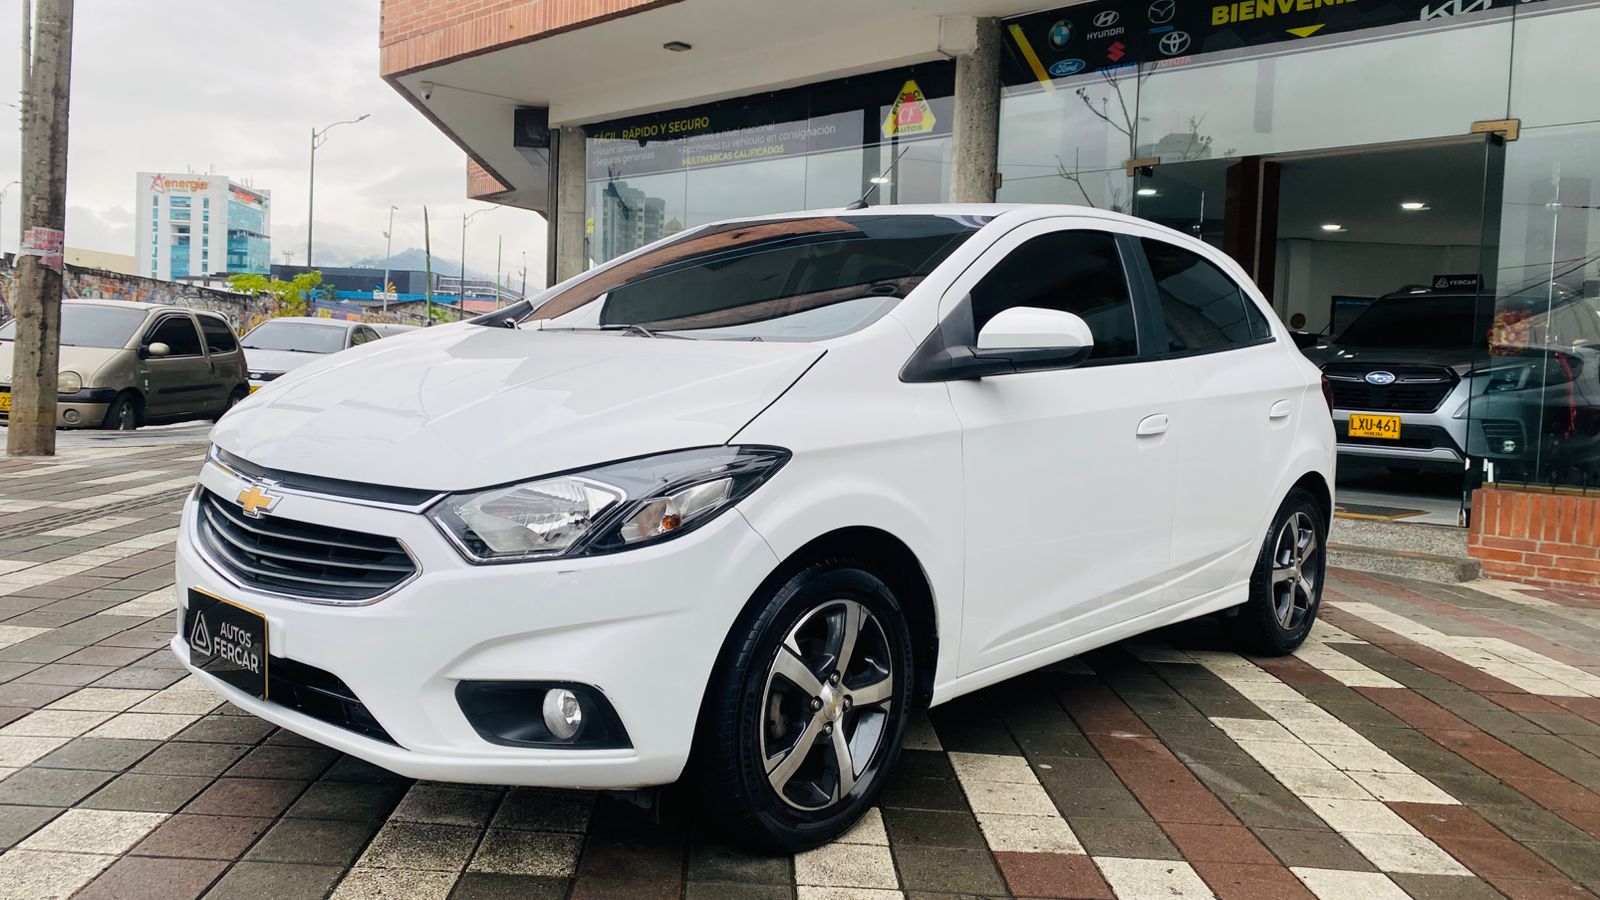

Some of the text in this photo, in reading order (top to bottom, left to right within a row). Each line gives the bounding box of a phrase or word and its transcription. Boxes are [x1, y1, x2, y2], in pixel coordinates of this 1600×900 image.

[1211, 0, 1357, 26] BIENVENI
[1086, 26, 1125, 40] HYUNDAI
[1056, 61, 1079, 73] Ford
[622, 125, 658, 140] RÁPIDO
[660, 123, 667, 134] Y
[668, 116, 710, 133] SEGURO
[722, 141, 730, 150] tu
[766, 134, 777, 143] en
[778, 124, 836, 141] consignación
[741, 121, 775, 134] nacional
[893, 124, 924, 134] Autos
[682, 145, 785, 166] MULTIMARCAS CALIFICADOS
[1350, 418, 1397, 432] LXU-461
[220, 622, 252, 648] AUTOS
[214, 637, 259, 674] FERCAR
